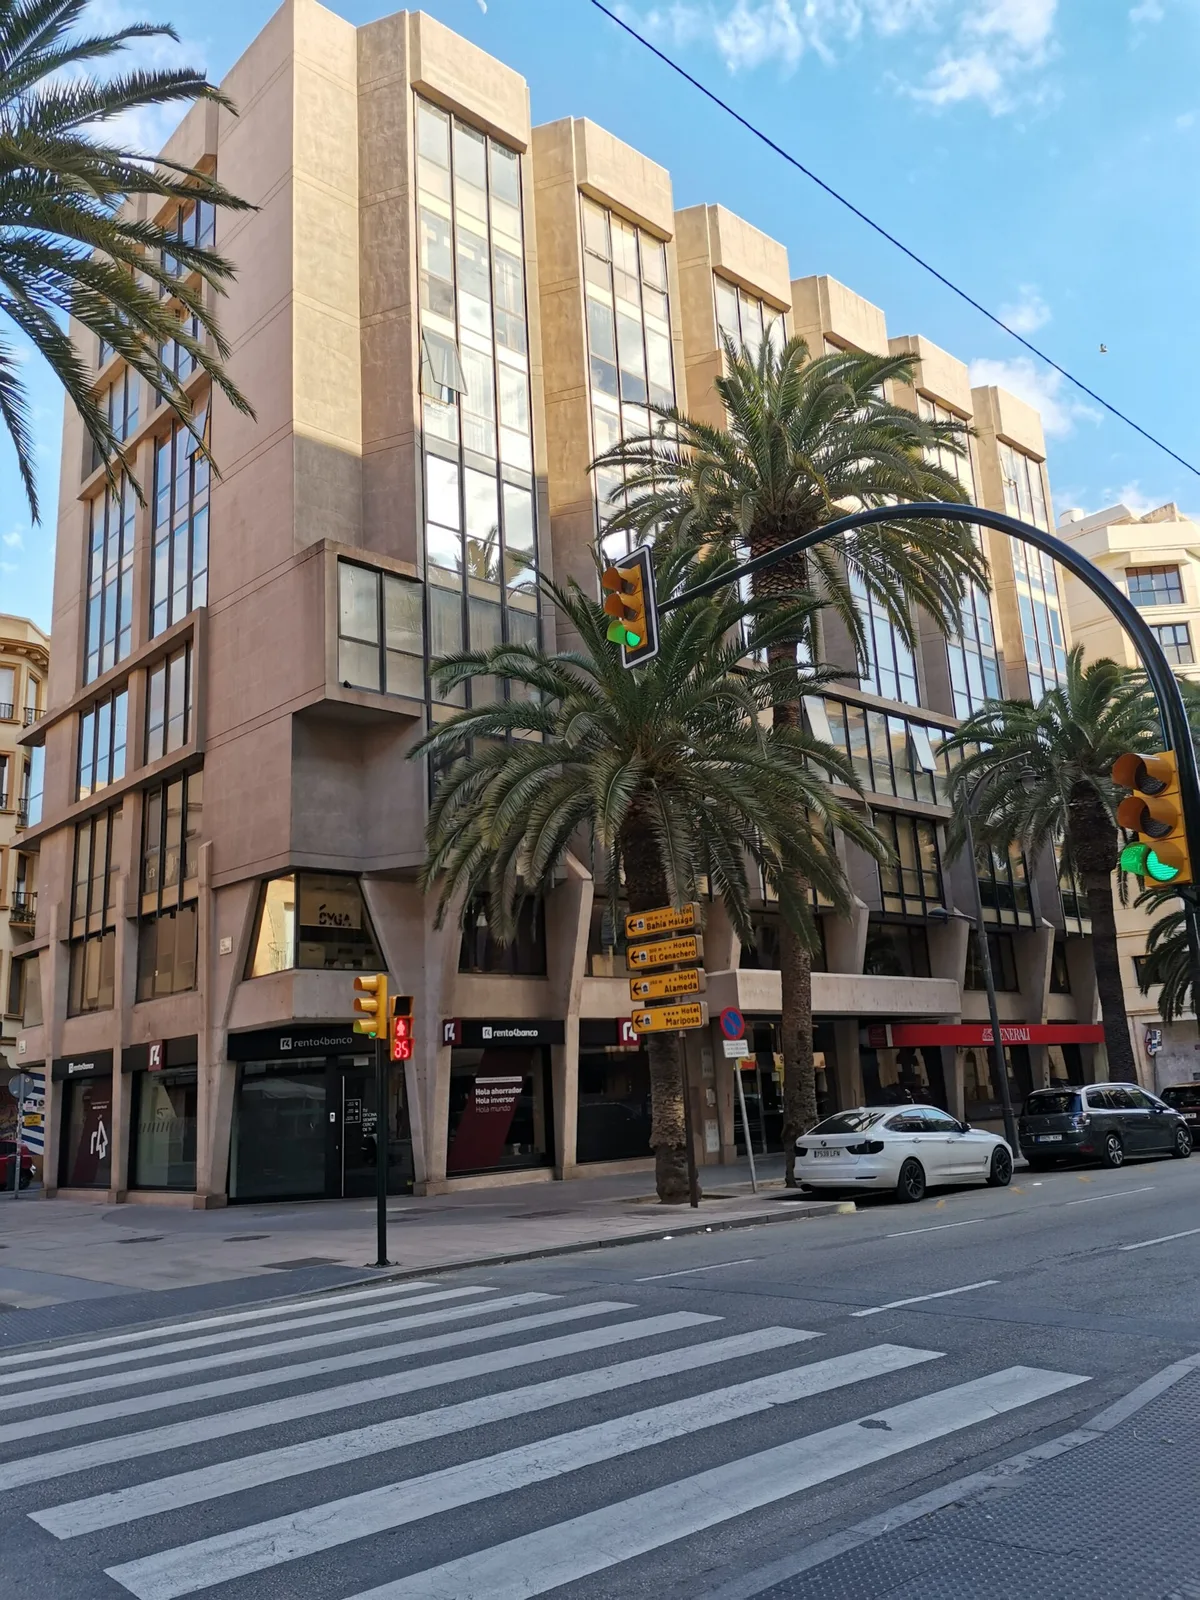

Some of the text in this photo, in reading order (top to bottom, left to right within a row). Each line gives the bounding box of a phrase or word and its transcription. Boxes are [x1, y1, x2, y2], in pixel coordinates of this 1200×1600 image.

[646, 914, 693, 931] Bahía Málaga
[673, 939, 695, 949] Hostal
[649, 949, 696, 963] El Cenachero
[678, 972, 697, 981] Hotel
[664, 981, 697, 994] Alameda
[681, 1006, 700, 1015] Hotel
[665, 1015, 700, 1027] Mariposa
[995, 1028, 1031, 1041] ENERALI
[475, 1086, 523, 1096] Hola ahorrador
[475, 1096, 515, 1104] Hola inversor
[475, 1104, 511, 1113] Hola mundo
